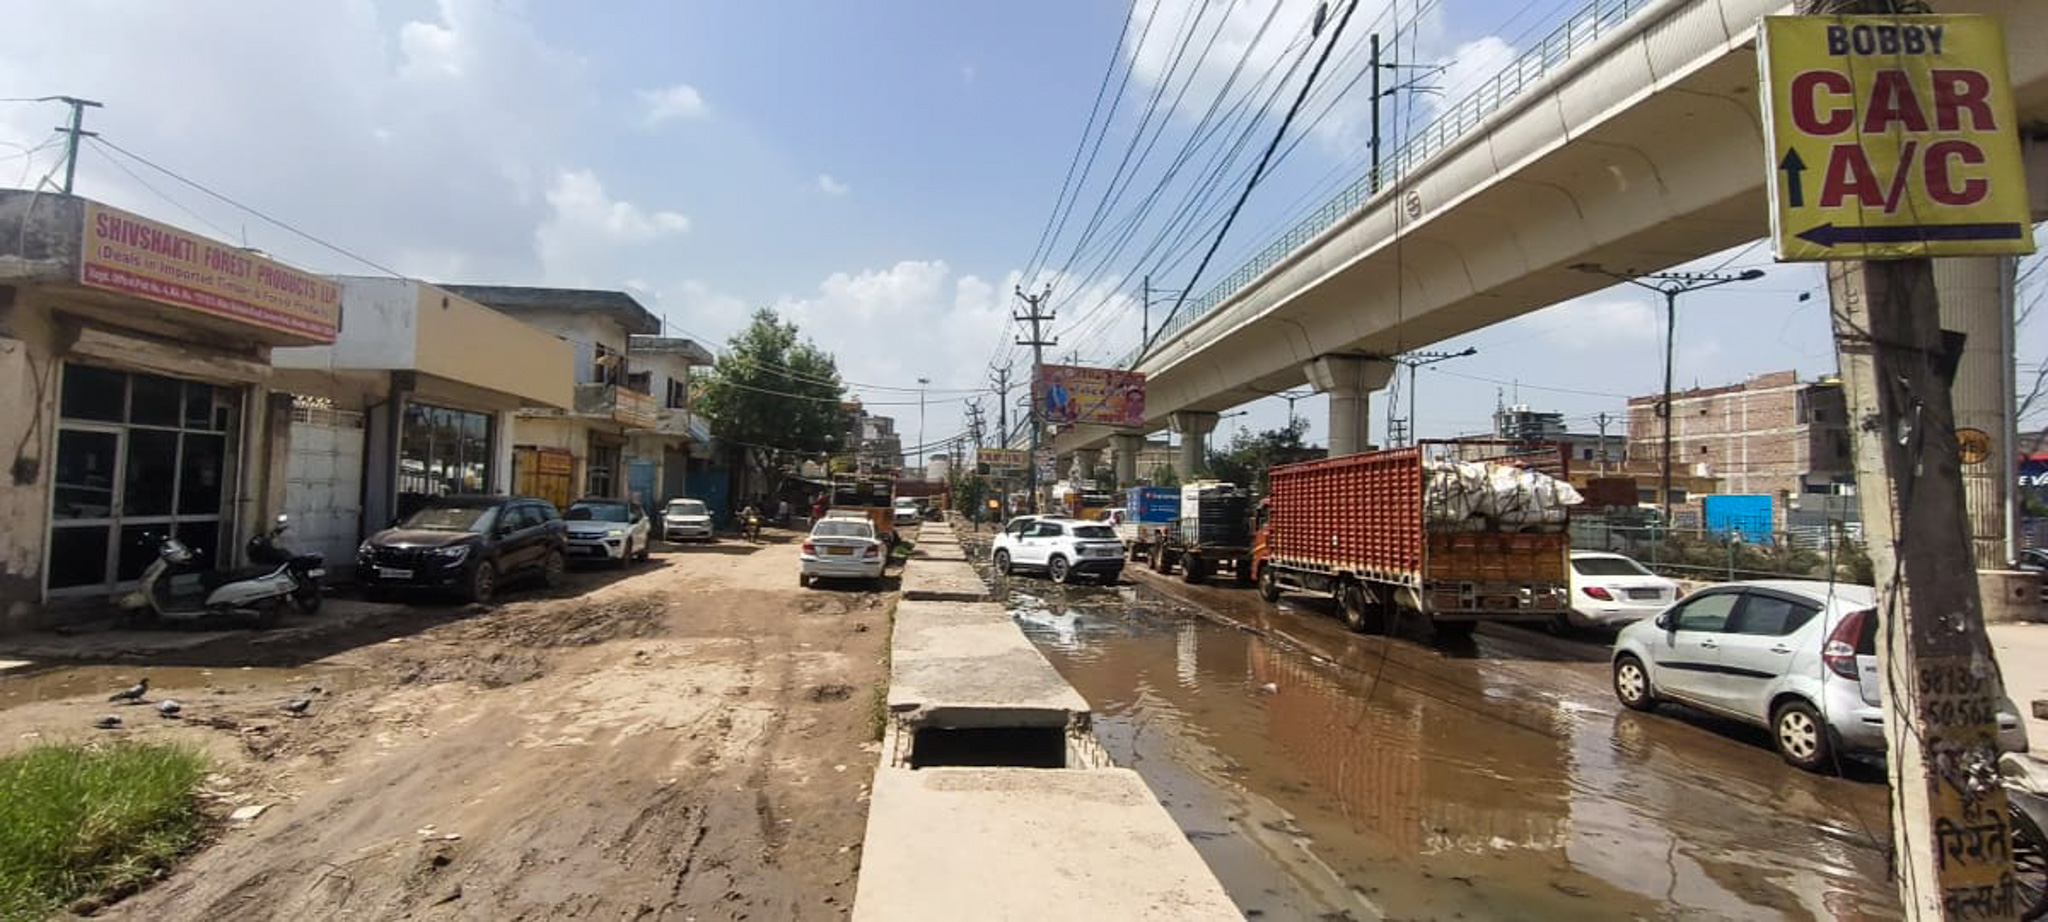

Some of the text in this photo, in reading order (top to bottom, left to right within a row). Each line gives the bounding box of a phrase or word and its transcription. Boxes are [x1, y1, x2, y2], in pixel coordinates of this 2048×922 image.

[1827, 25, 1943, 55] BOBBY
[1790, 69, 1997, 135] CAR
[1819, 140, 1989, 213] A/C
[96, 212, 197, 264] SHIVSHAKTI
[205, 246, 252, 279] FOREST
[258, 264, 317, 299] PRODUCTS
[160, 262, 213, 286] Imported
